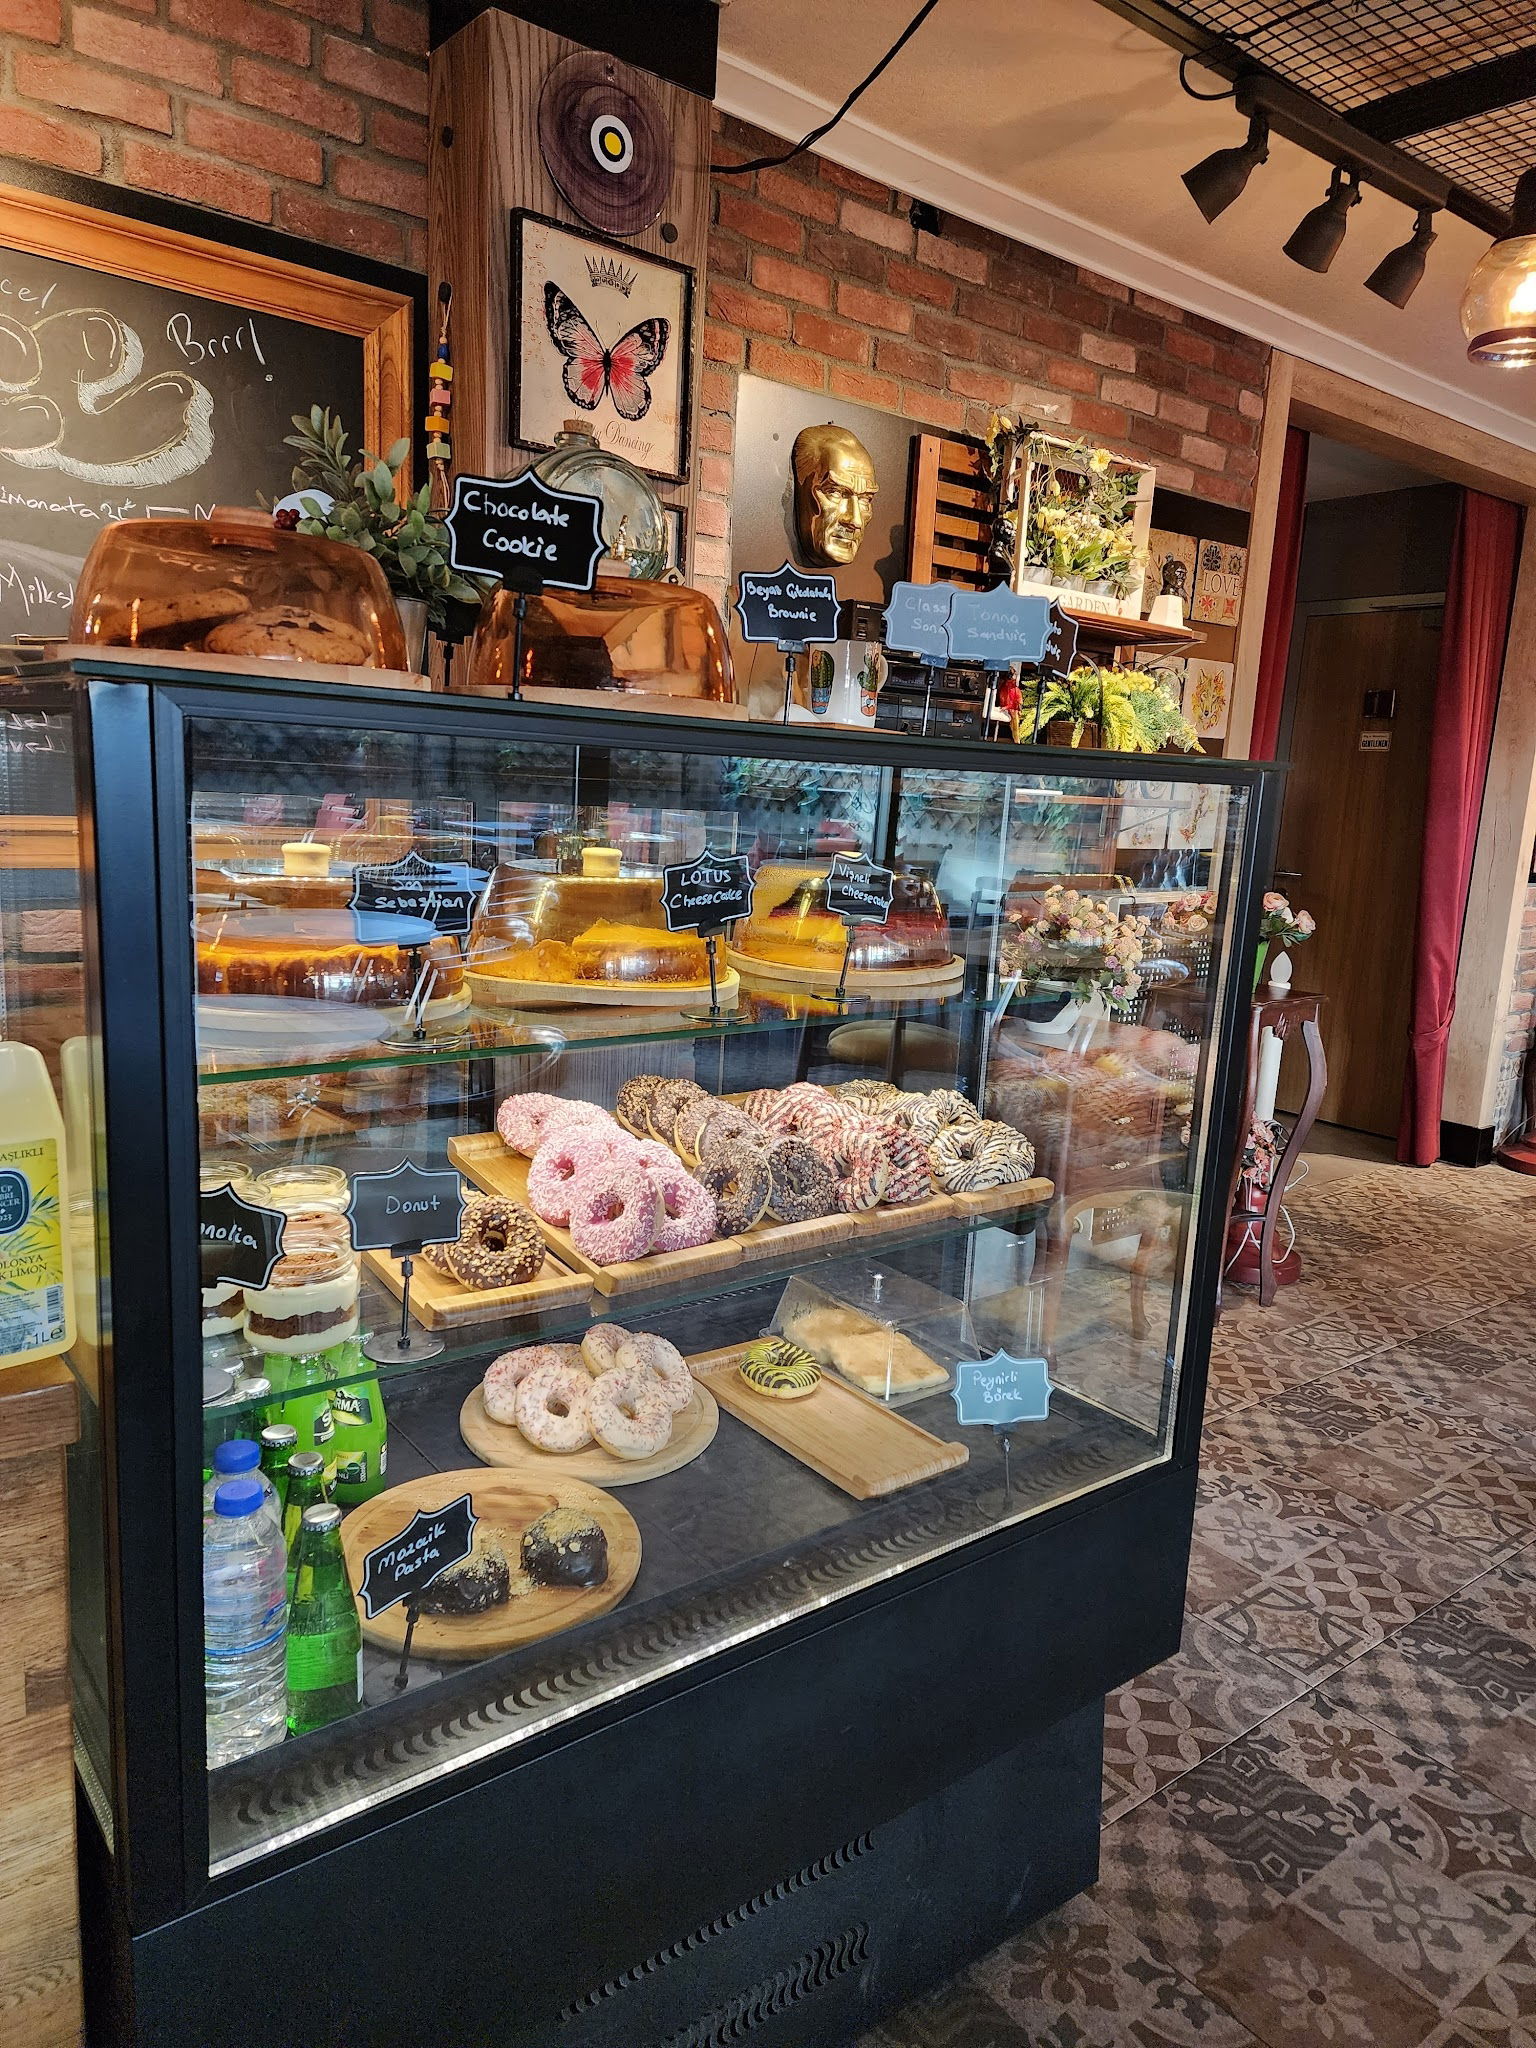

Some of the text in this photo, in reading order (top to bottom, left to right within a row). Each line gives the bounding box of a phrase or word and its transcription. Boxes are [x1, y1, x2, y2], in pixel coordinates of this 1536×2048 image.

[463, 490, 570, 527] Chocolate
[482, 528, 558, 561] Cookie
[1203, 572, 1240, 597] LOVE
[767, 603, 817, 622] Brownie
[905, 597, 948, 614] Class
[680, 868, 732, 887] LOTUS
[386, 1195, 440, 1215] Donut
[973, 1370, 1018, 1391] Peynirli
[983, 1387, 1022, 1404] Börek
[378, 1522, 446, 1574] Mozaik
[394, 1548, 440, 1582] Pasta
